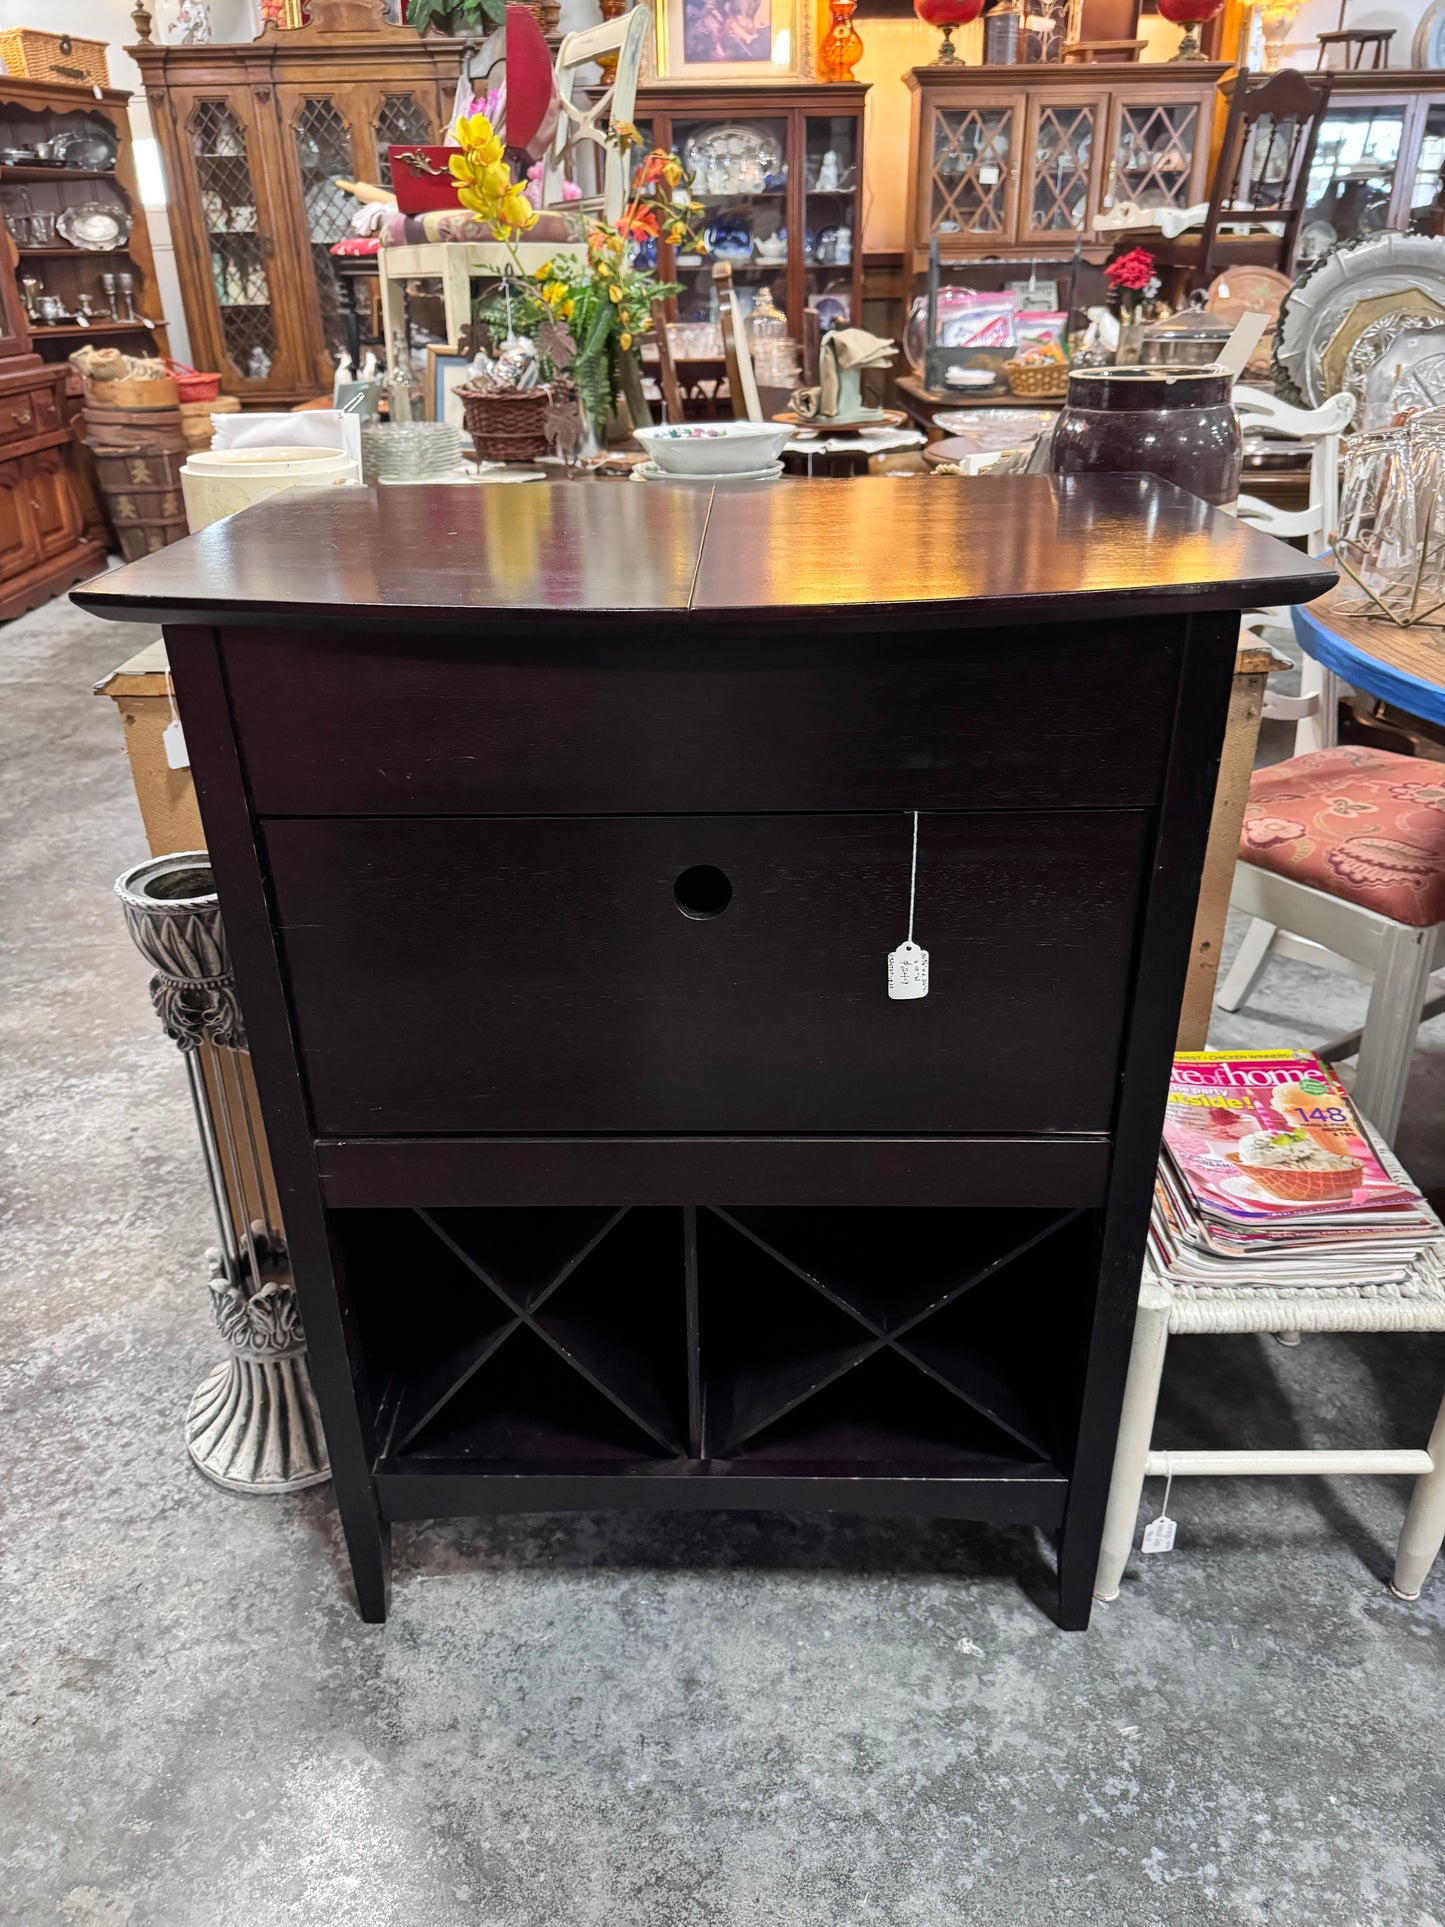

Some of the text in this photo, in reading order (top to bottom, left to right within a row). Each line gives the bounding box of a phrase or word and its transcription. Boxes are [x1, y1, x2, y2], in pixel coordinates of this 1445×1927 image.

[1170, 1066, 1203, 1085] te
[1221, 1062, 1325, 1087] home
[1190, 1087, 1228, 1097] party
[1294, 1107, 1347, 1122] 148
